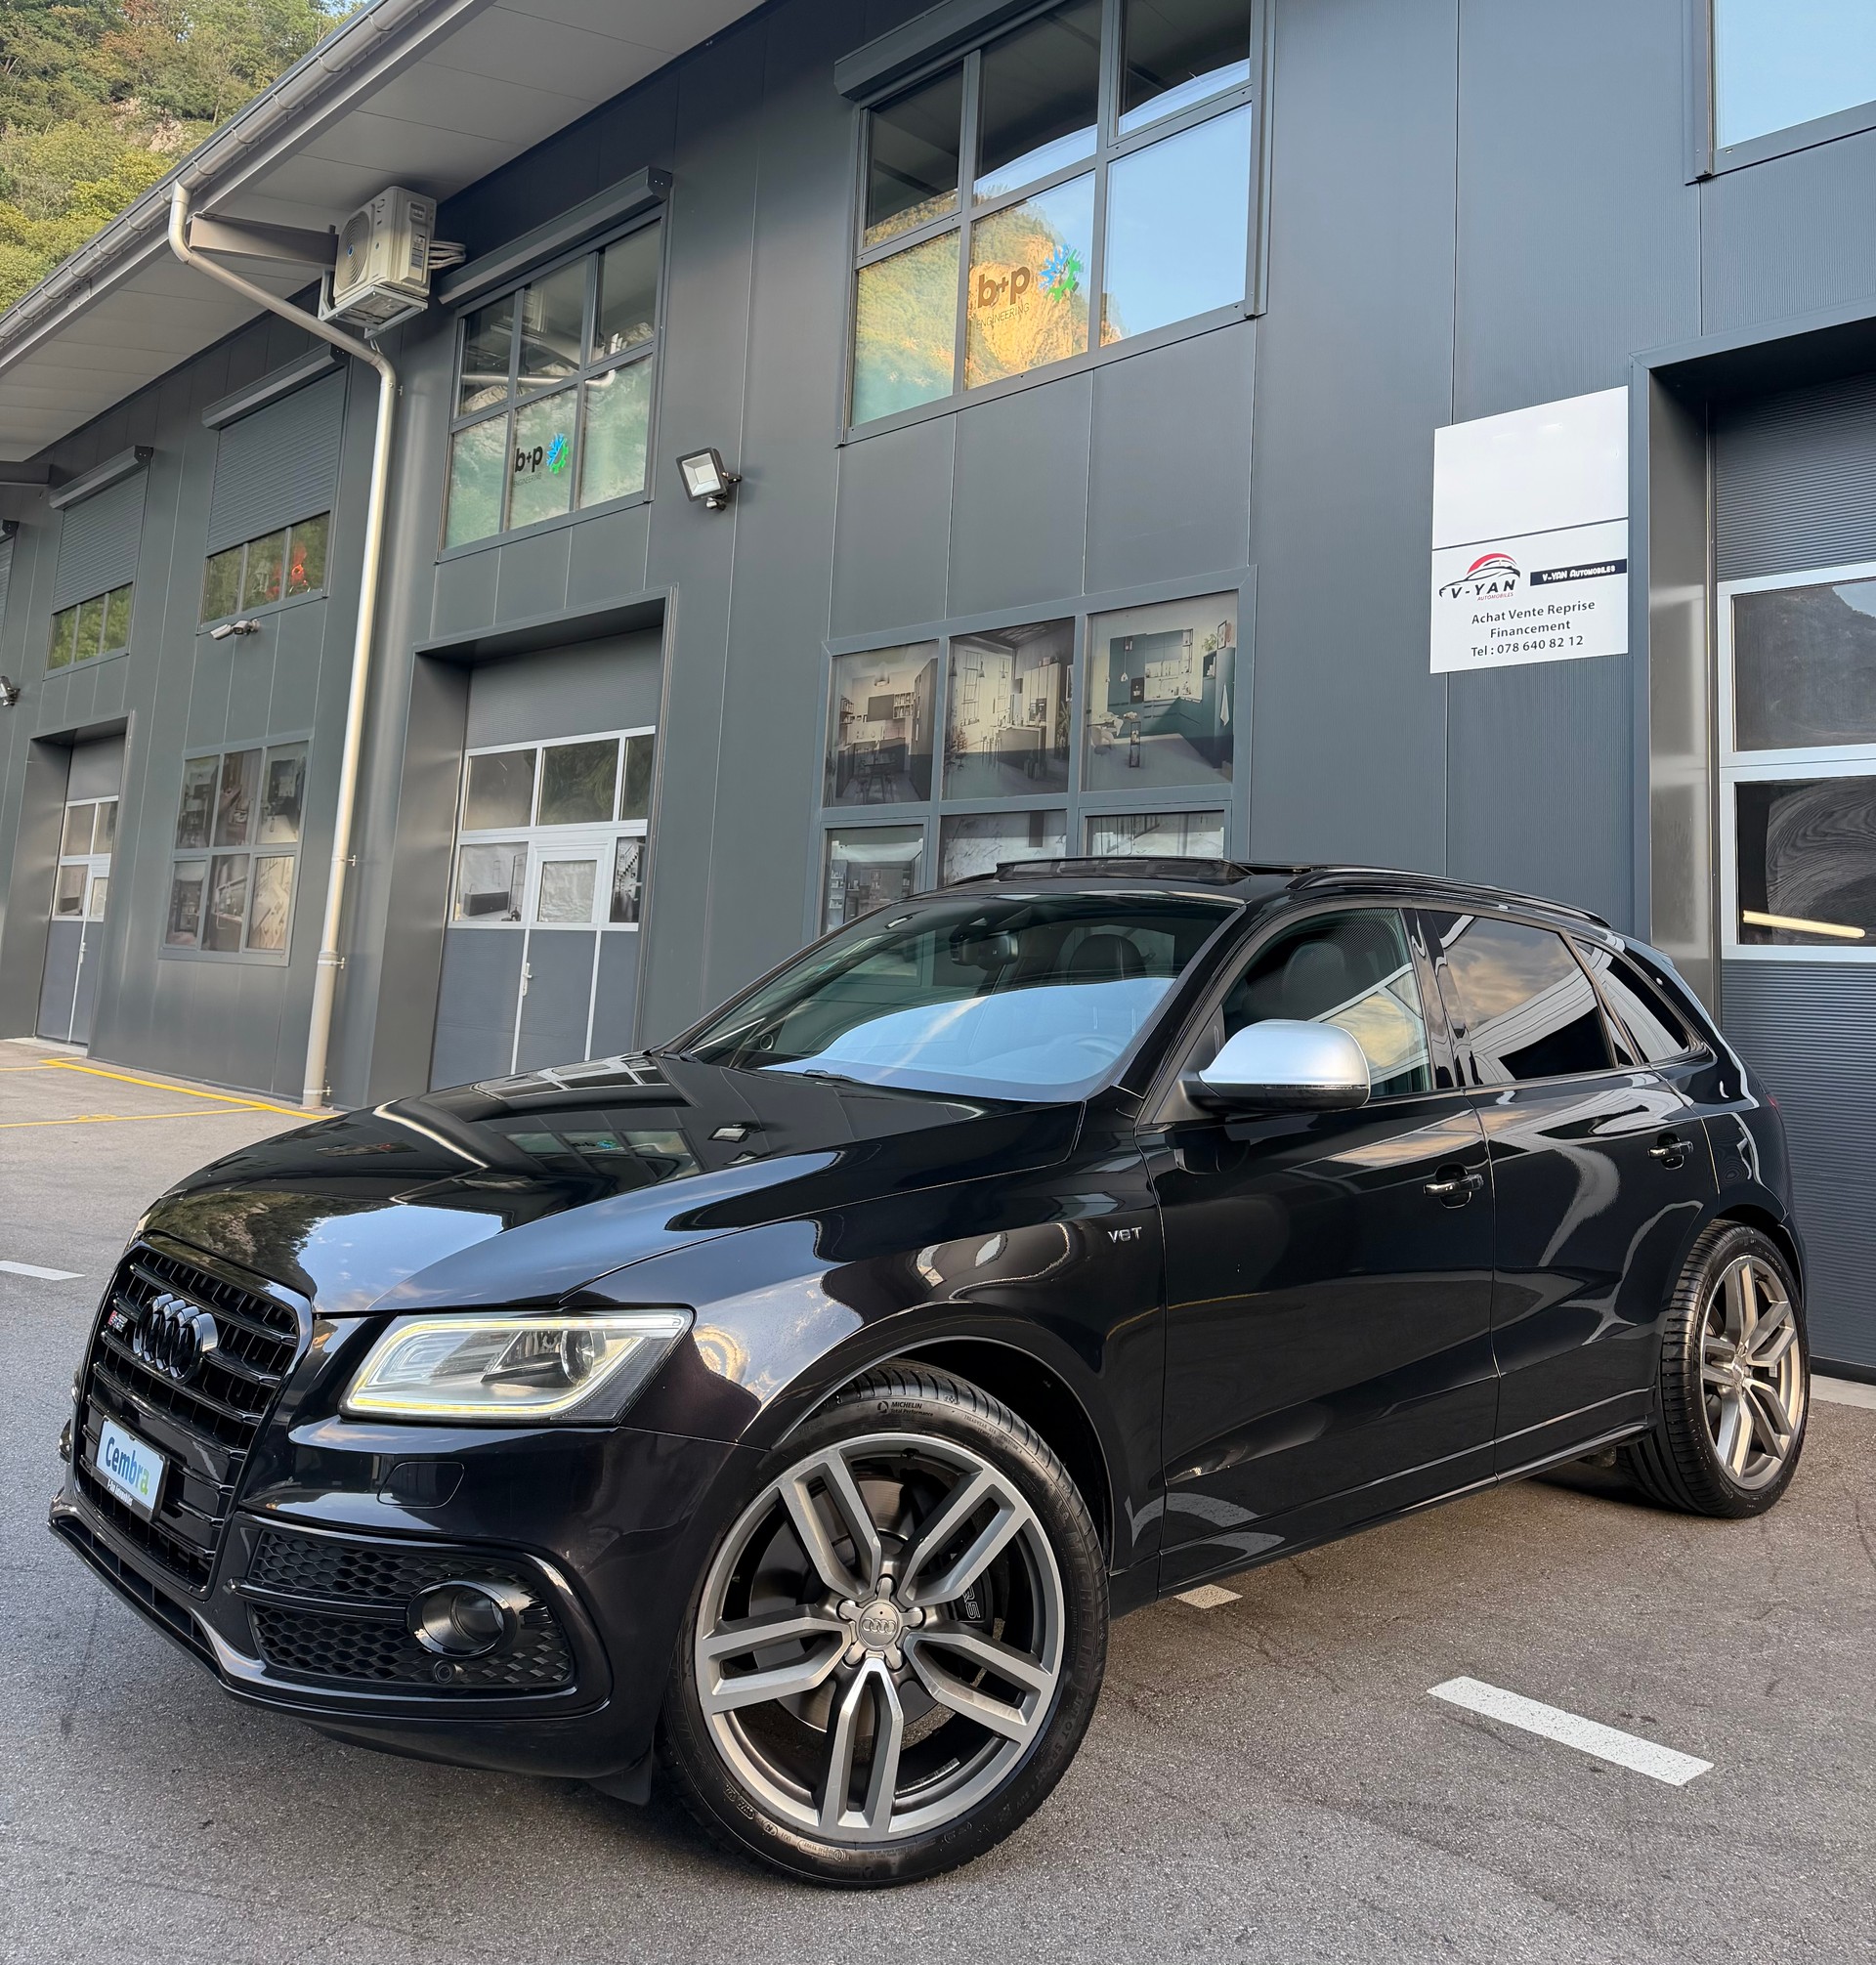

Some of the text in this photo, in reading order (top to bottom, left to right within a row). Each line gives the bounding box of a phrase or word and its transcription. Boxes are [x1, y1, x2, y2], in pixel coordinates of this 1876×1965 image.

[978, 267, 1031, 309] b+p
[977, 303, 1029, 329] ENGINEERING
[515, 446, 543, 473] b+p
[1542, 570, 1567, 581] V-YAN
[1451, 578, 1515, 599] V-YAN
[1476, 592, 1514, 601] AUTOMOBILES
[1471, 600, 1596, 624] Achat Vente Reprise
[1490, 619, 1571, 638] Financement
[1497, 643, 1519, 654] 078
[1522, 639, 1546, 652] 640
[1549, 637, 1564, 648] 82
[1568, 635, 1584, 646] 12
[891, 1401, 923, 1410] MICHELIN
[105, 1436, 149, 1495] Cembra
